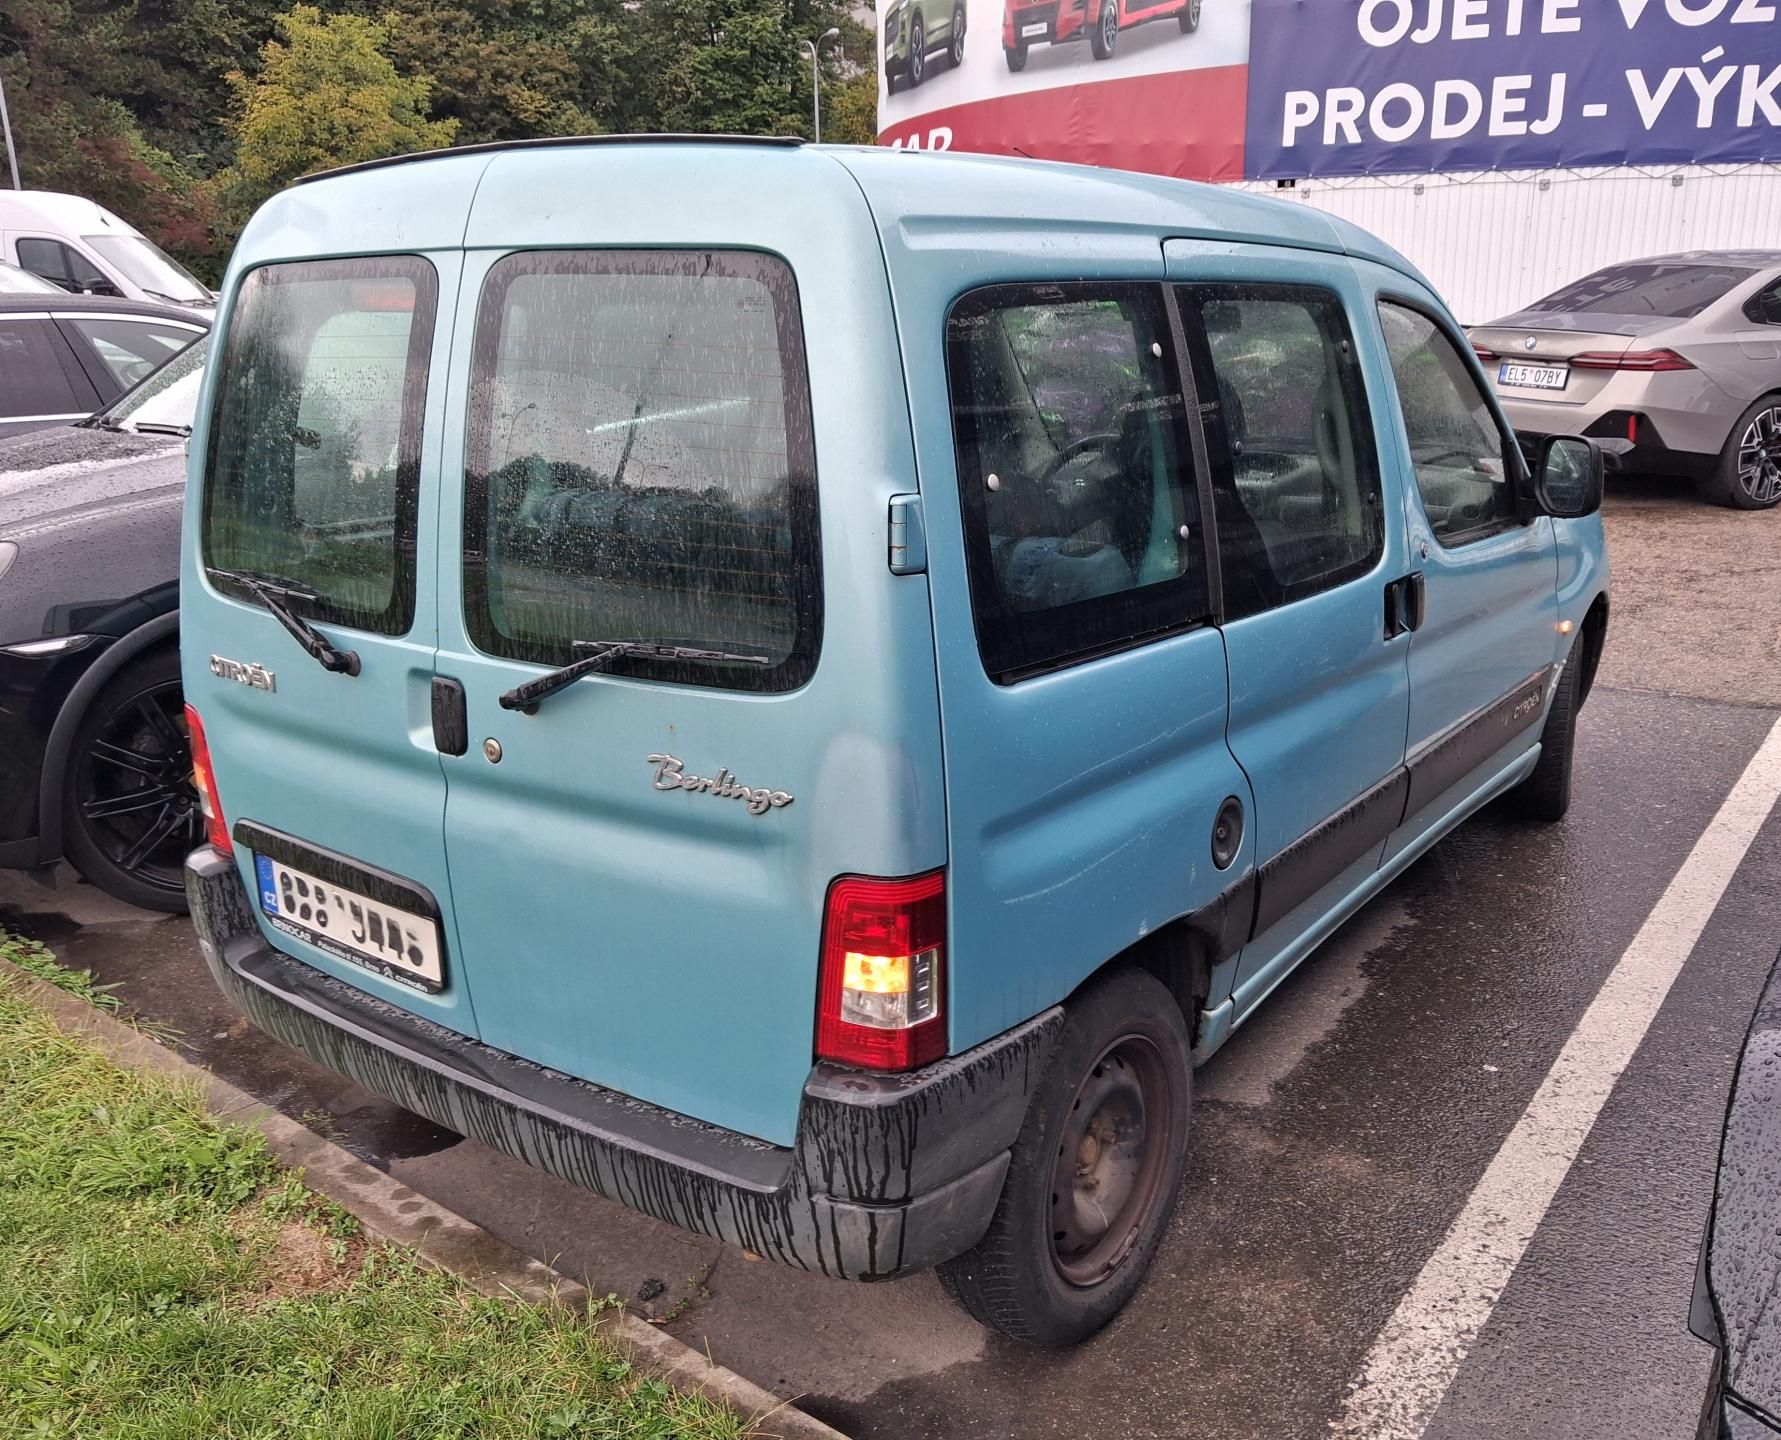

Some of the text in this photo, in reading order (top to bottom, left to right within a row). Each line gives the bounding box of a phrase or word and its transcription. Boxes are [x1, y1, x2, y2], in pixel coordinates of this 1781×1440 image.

[1282, 45, 1781, 147] PRODEJ - VÝK
[1507, 367, 1529, 381] EL5
[208, 654, 277, 693] CITROËN
[647, 753, 794, 815] Berlingo
[264, 891, 277, 906] CZ
